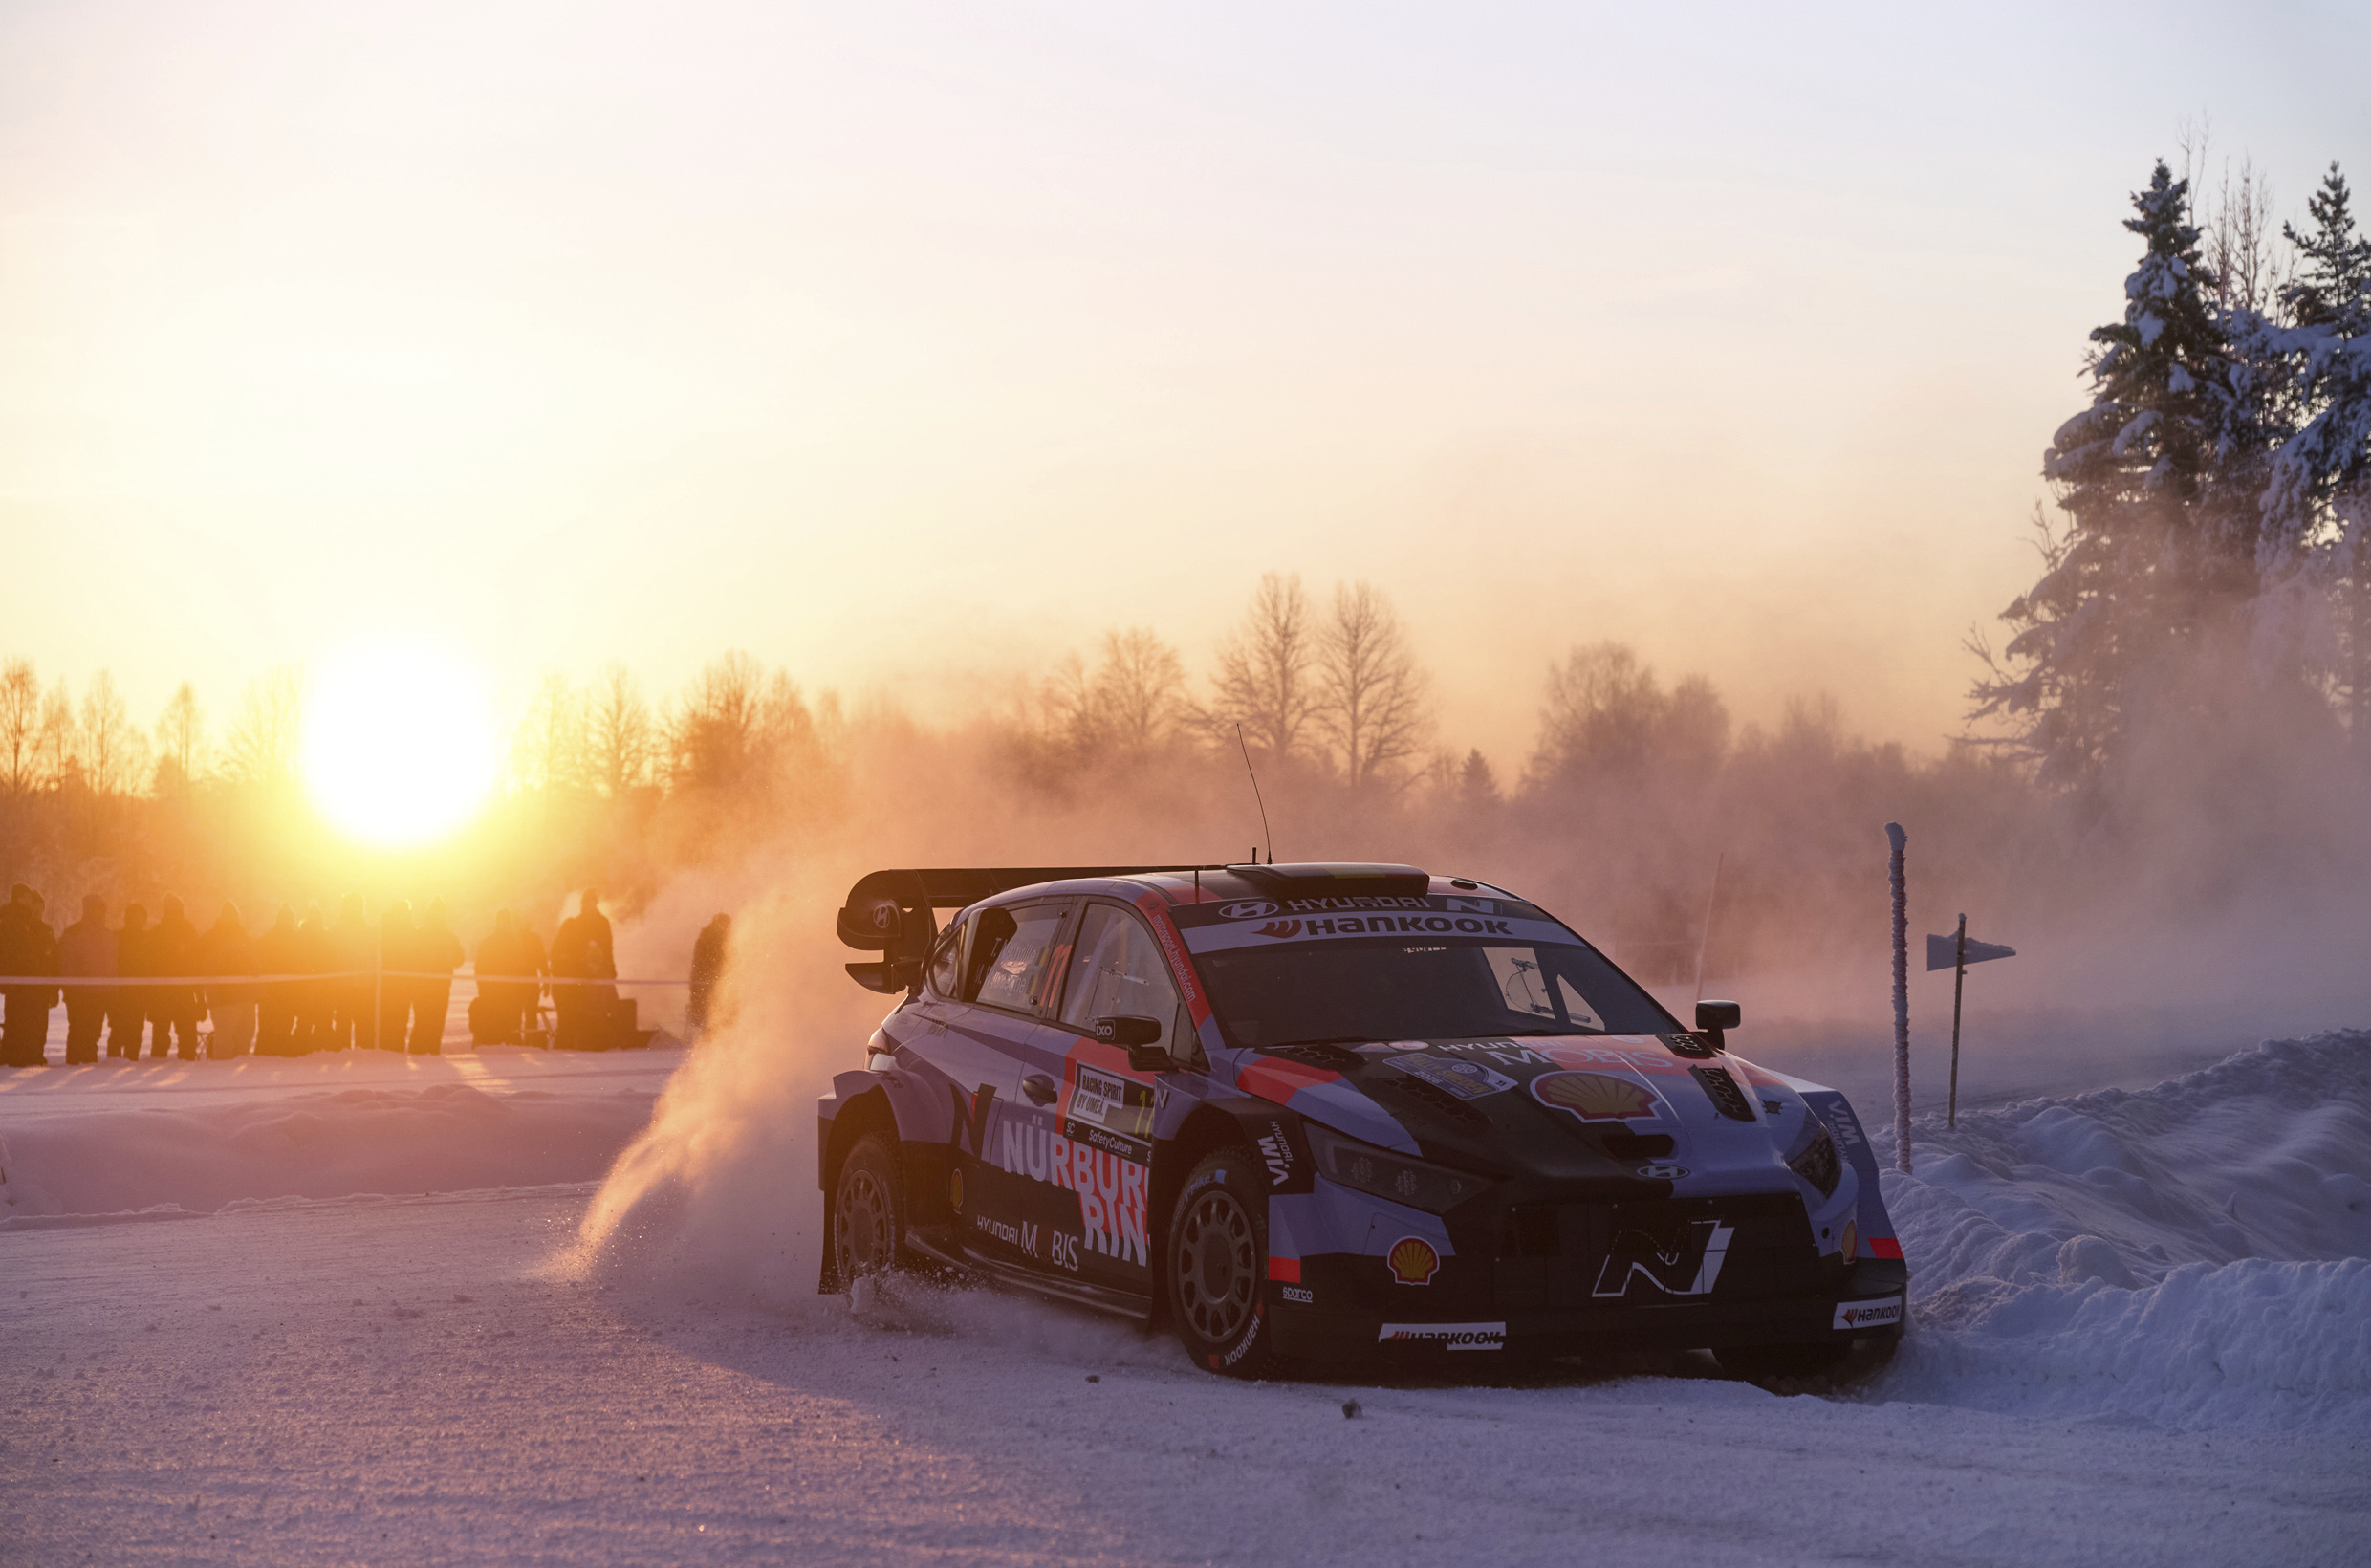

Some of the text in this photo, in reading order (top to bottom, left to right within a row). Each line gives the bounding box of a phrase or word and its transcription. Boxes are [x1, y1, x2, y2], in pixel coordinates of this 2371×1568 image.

[1289, 897, 1432, 911] HYUNDAI
[1153, 914, 1196, 1002] motorsport.hyundai.com
[1438, 1040, 1565, 1052] HYUNDAI
[1485, 1048, 1673, 1068] MOBIS
[1077, 1093, 1086, 1109] BY
[1082, 1074, 1122, 1102] RACING SPIRIT
[1066, 1122, 1076, 1135] SC
[1088, 1129, 1132, 1155] SafetyCulture
[1269, 1121, 1294, 1162] HYUNDAI
[1004, 1113, 1149, 1211] NÜRBUR
[977, 1214, 1019, 1245] HYUNDAI
[1080, 1191, 1151, 1268] RIN
[1282, 1286, 1314, 1301] sparco
